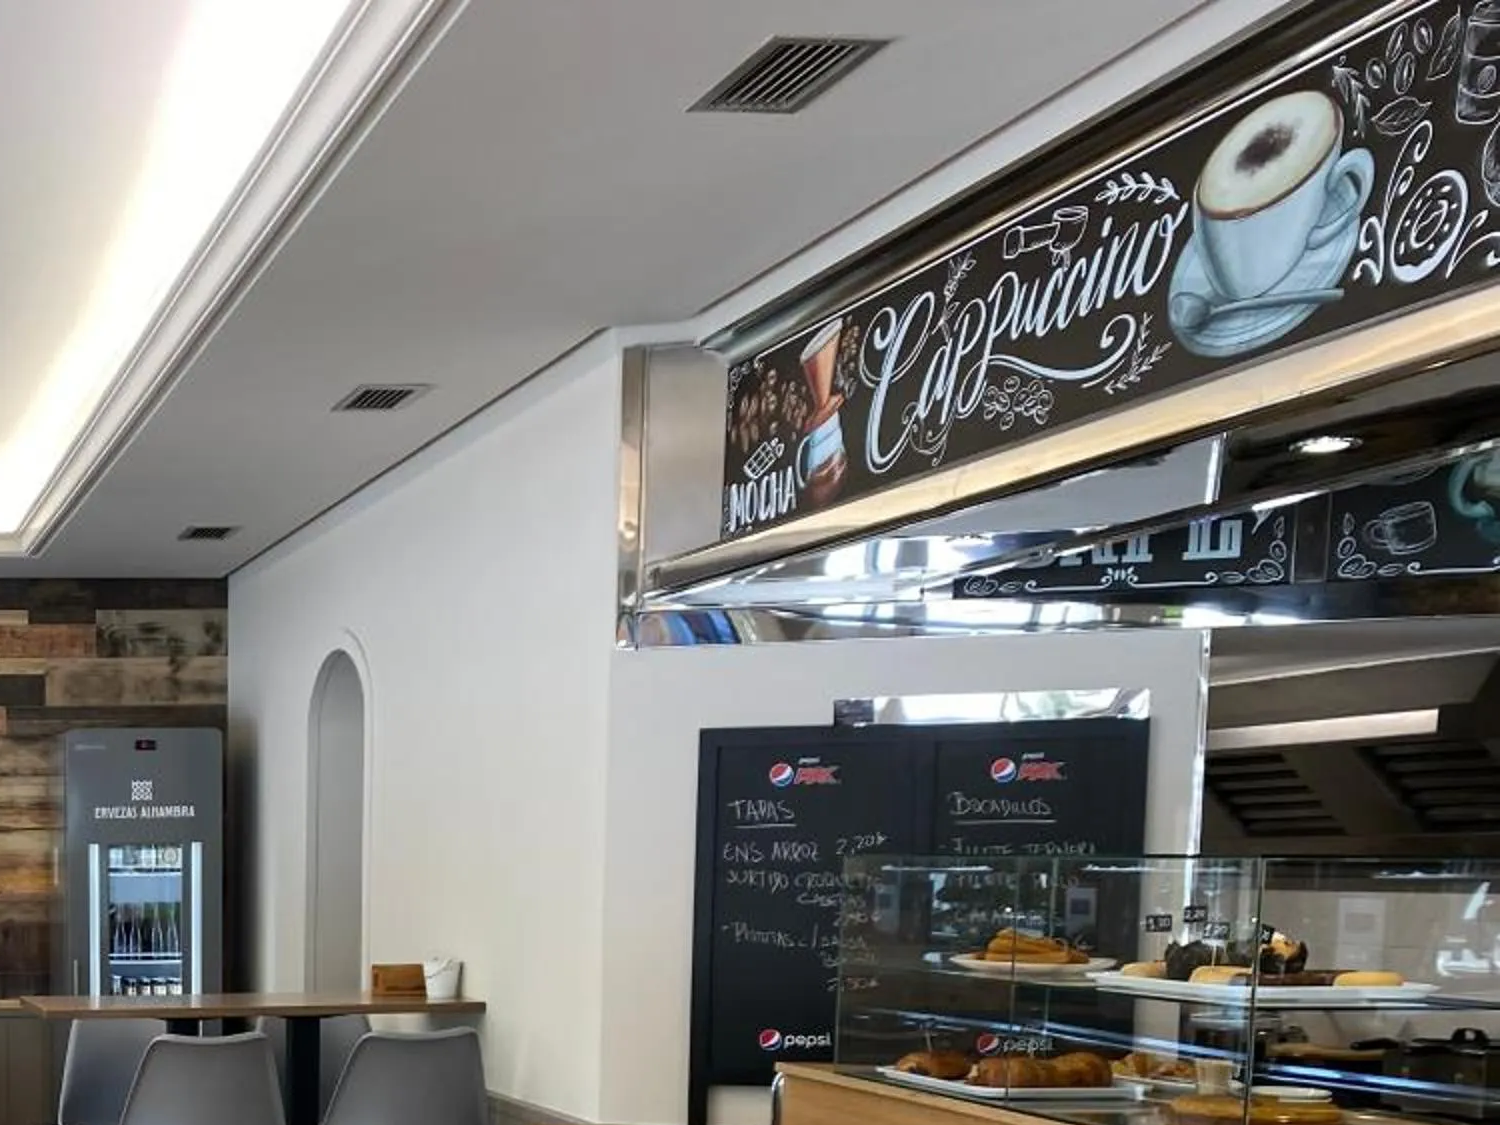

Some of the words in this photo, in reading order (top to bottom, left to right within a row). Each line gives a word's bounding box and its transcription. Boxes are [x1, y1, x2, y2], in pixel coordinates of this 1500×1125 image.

[860, 202, 1188, 474] Cappuccino
[727, 465, 798, 533] MOCHA
[140, 805, 195, 818] ALHAMBRA
[783, 1031, 832, 1049] pepsi
